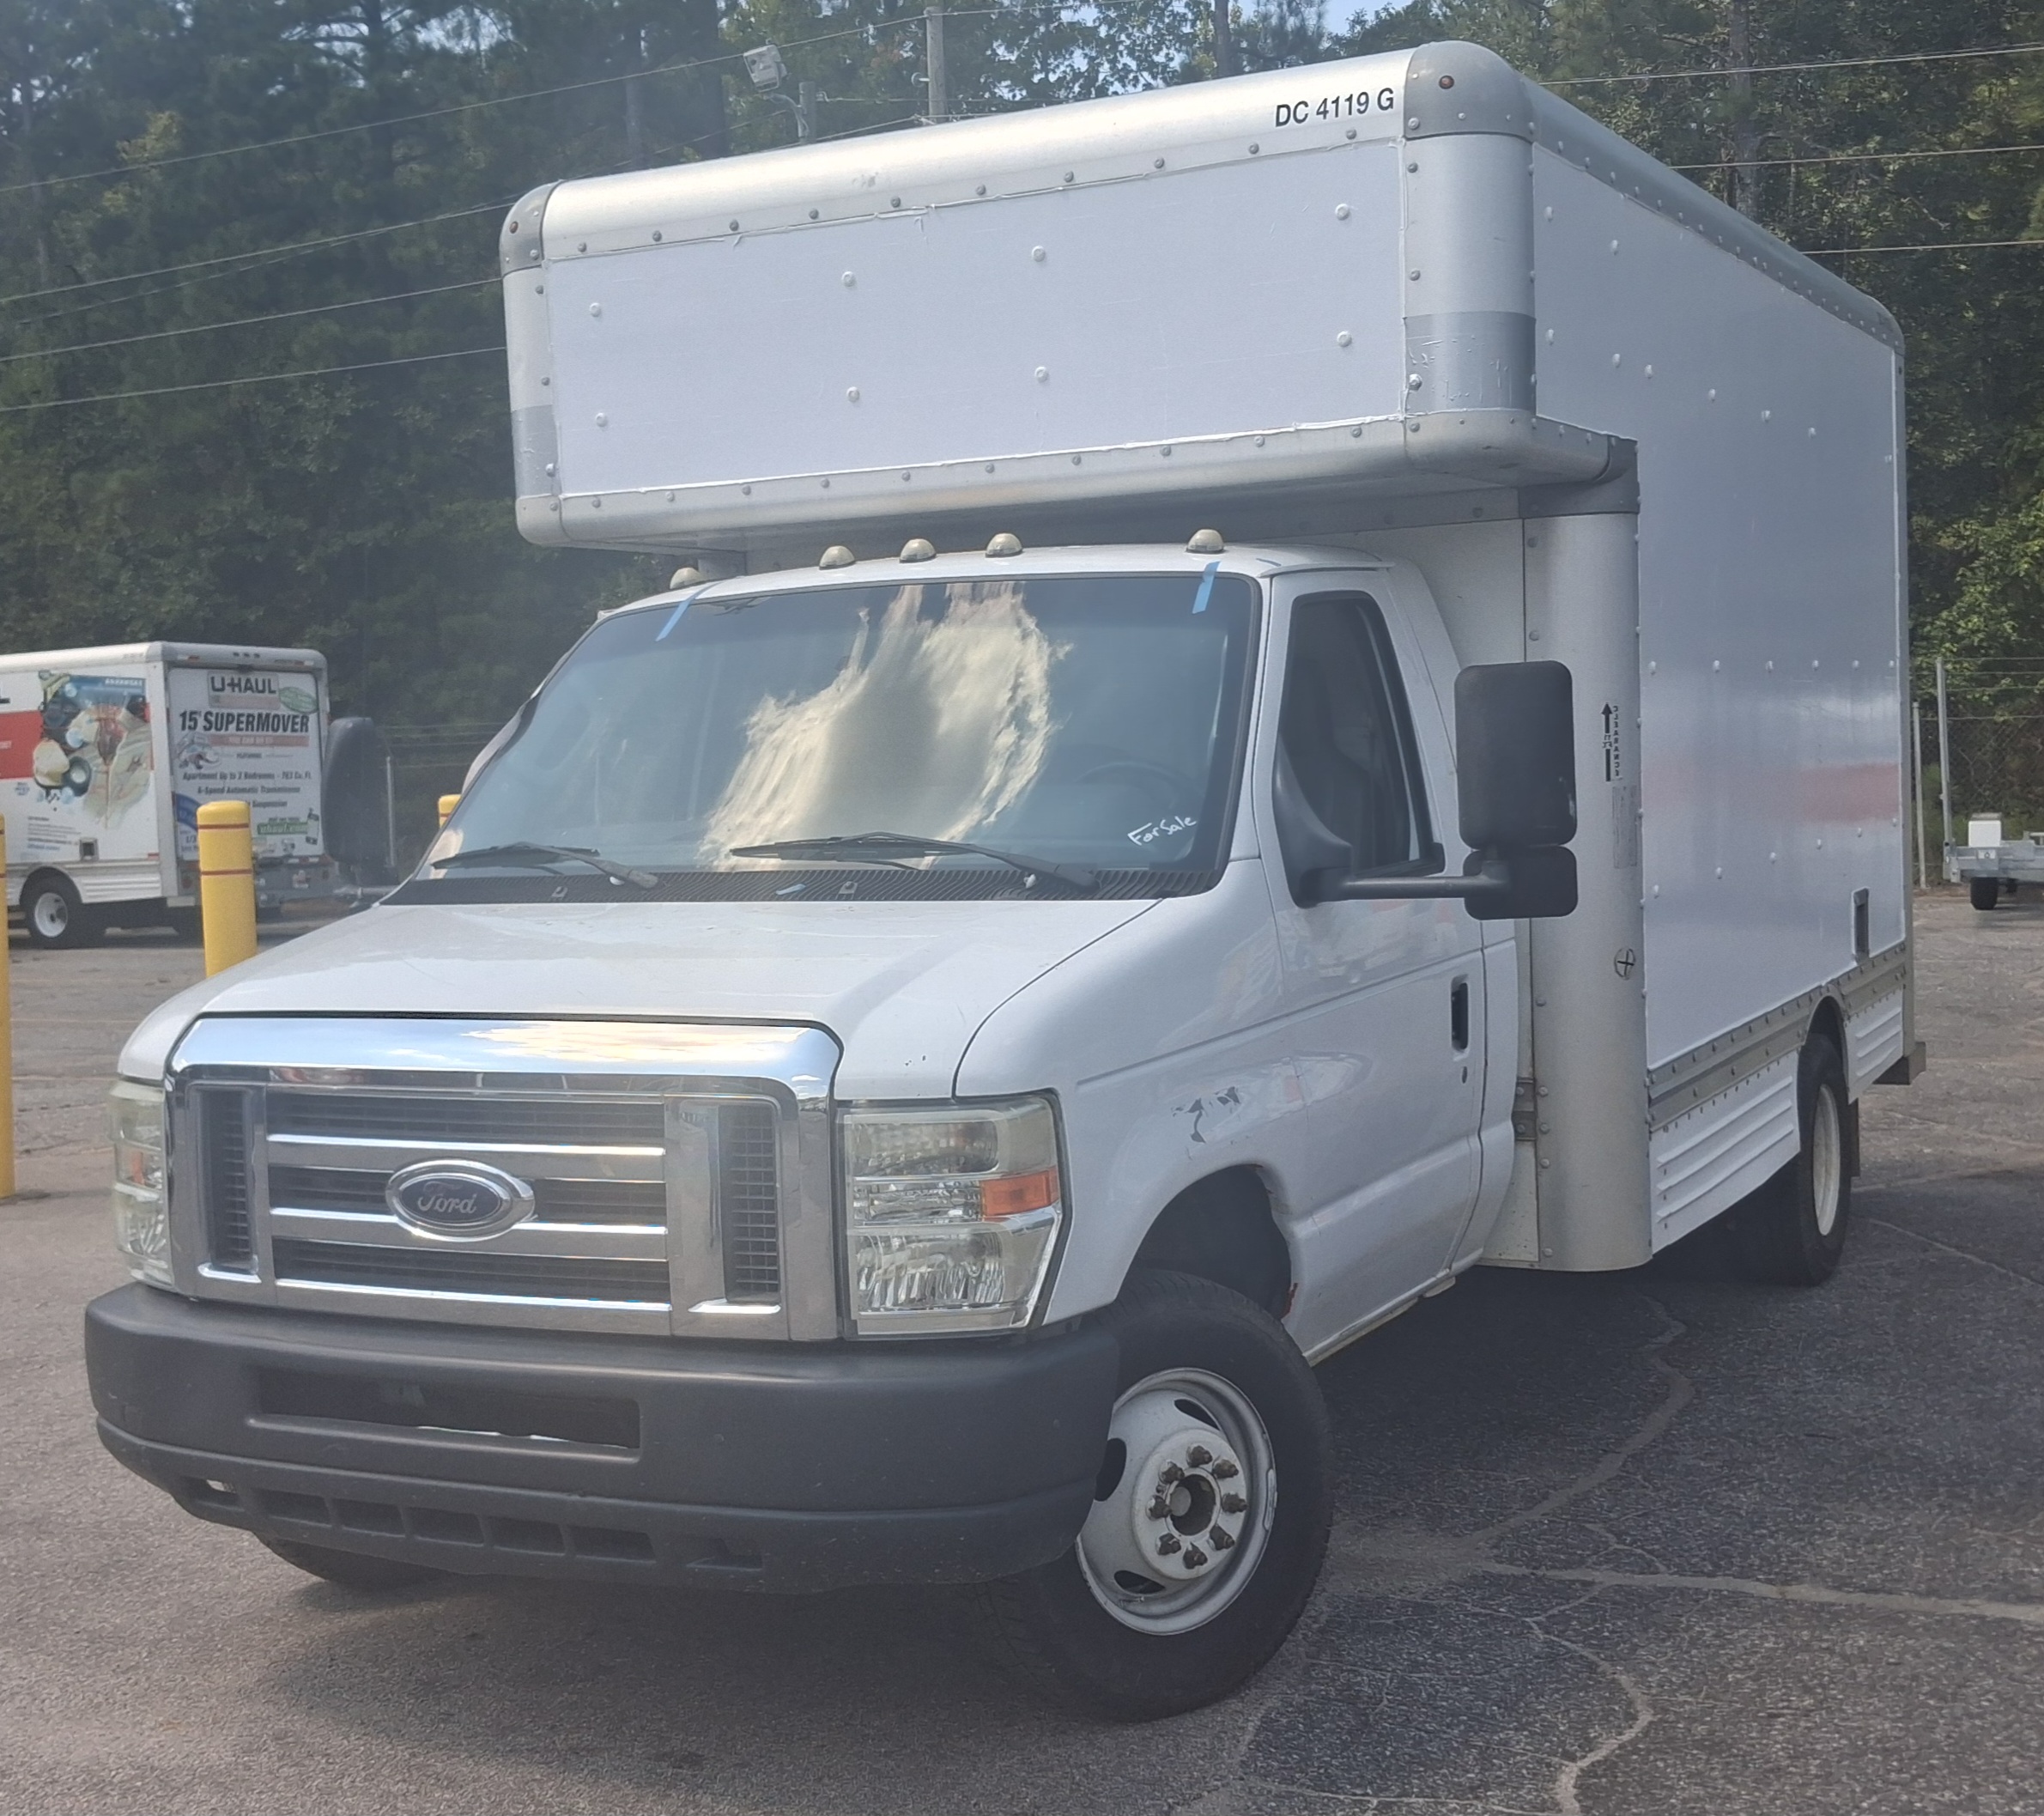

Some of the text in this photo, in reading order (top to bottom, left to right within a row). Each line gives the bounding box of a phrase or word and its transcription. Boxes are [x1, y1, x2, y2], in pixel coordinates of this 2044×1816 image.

[1275, 88, 1394, 127] DC 4119 G
[210, 676, 276, 694] U-HAUL
[203, 711, 310, 732] SUPERMOVER
[1127, 816, 1197, 846] For Sale
[417, 1180, 477, 1214] Ford
